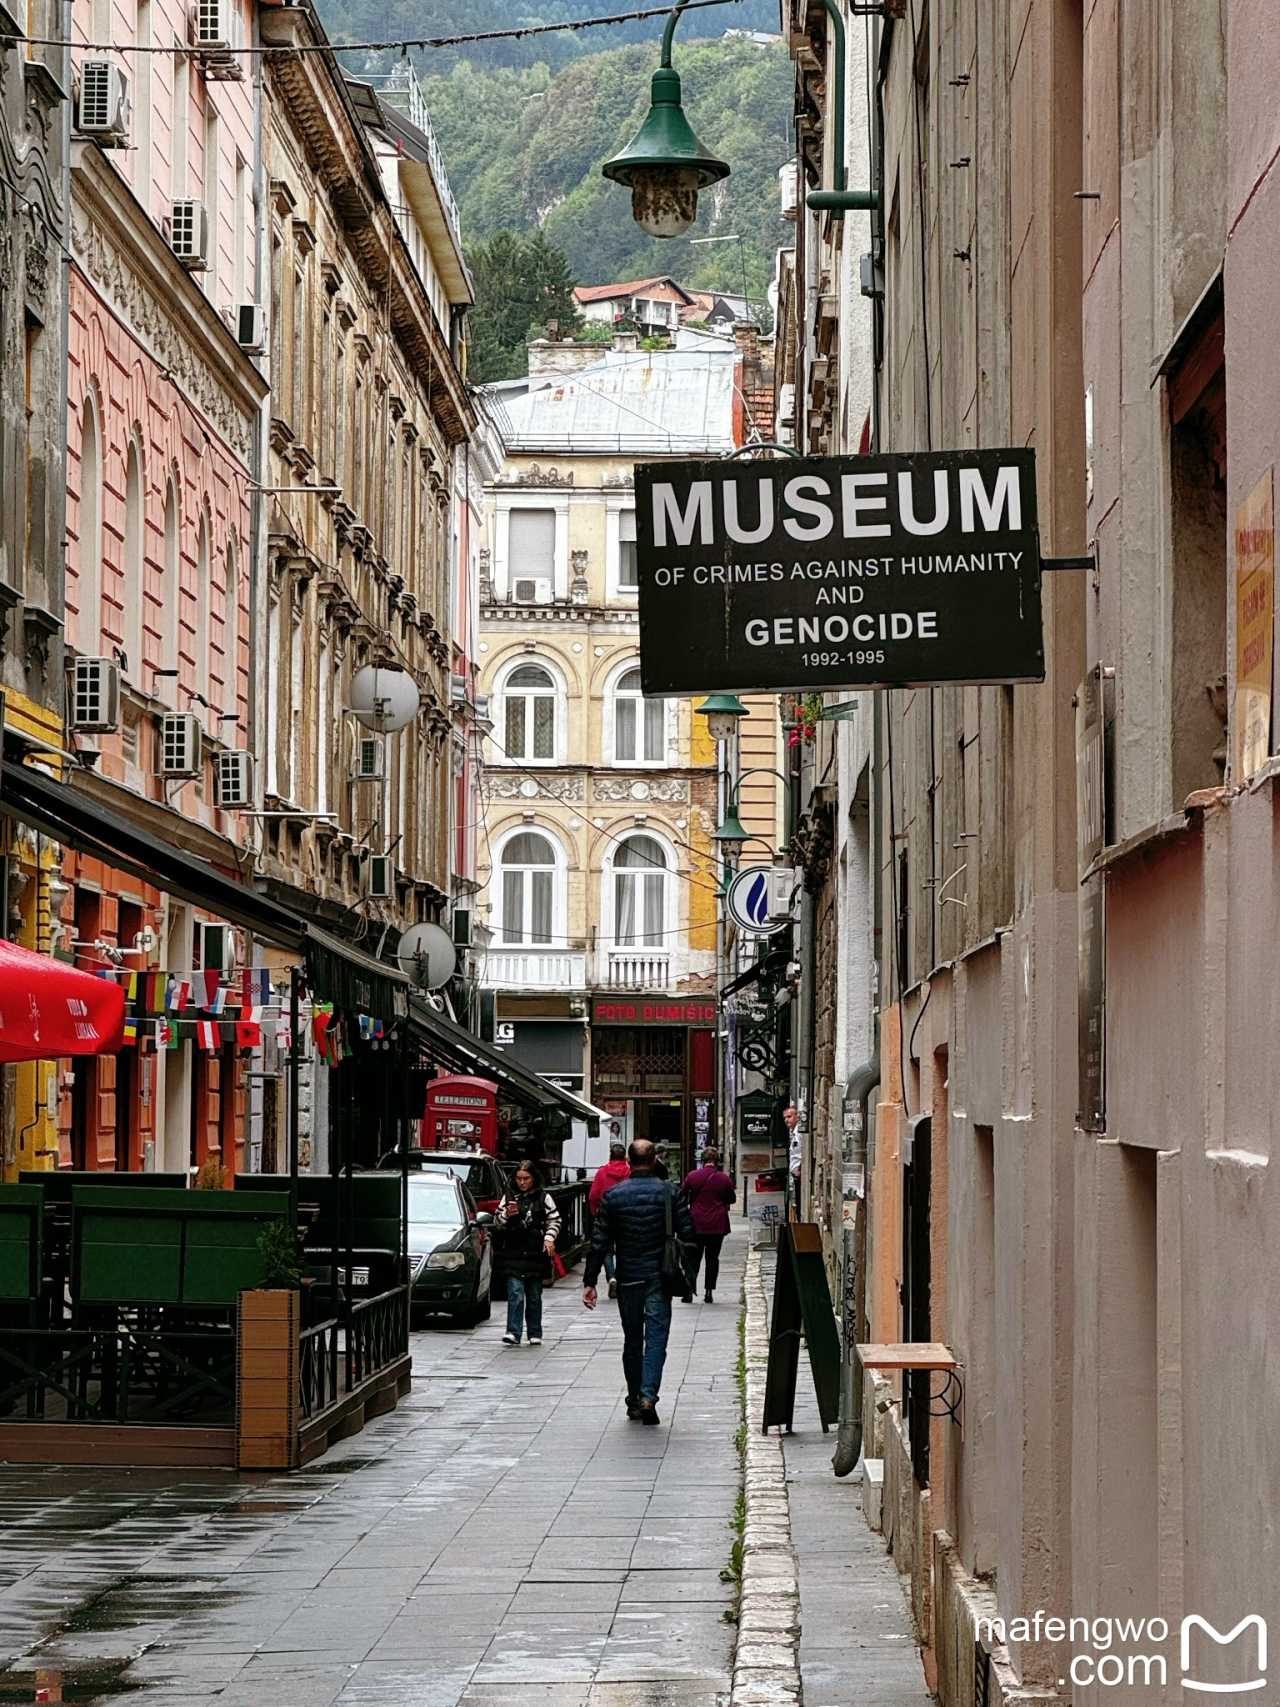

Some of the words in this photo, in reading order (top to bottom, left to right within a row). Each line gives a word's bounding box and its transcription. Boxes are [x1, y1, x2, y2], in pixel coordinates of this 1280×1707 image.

[652, 466, 1022, 547] MUSEUM
[655, 567, 685, 586] OF
[693, 562, 784, 584] CRIMES
[790, 556, 894, 580] AGAINST
[901, 551, 1023, 576] HUMANITY
[815, 585, 864, 605] AND
[744, 611, 939, 646] GENOCIDE
[801, 650, 885, 667] 1992-1995
[596, 1006, 635, 1020] FOTO
